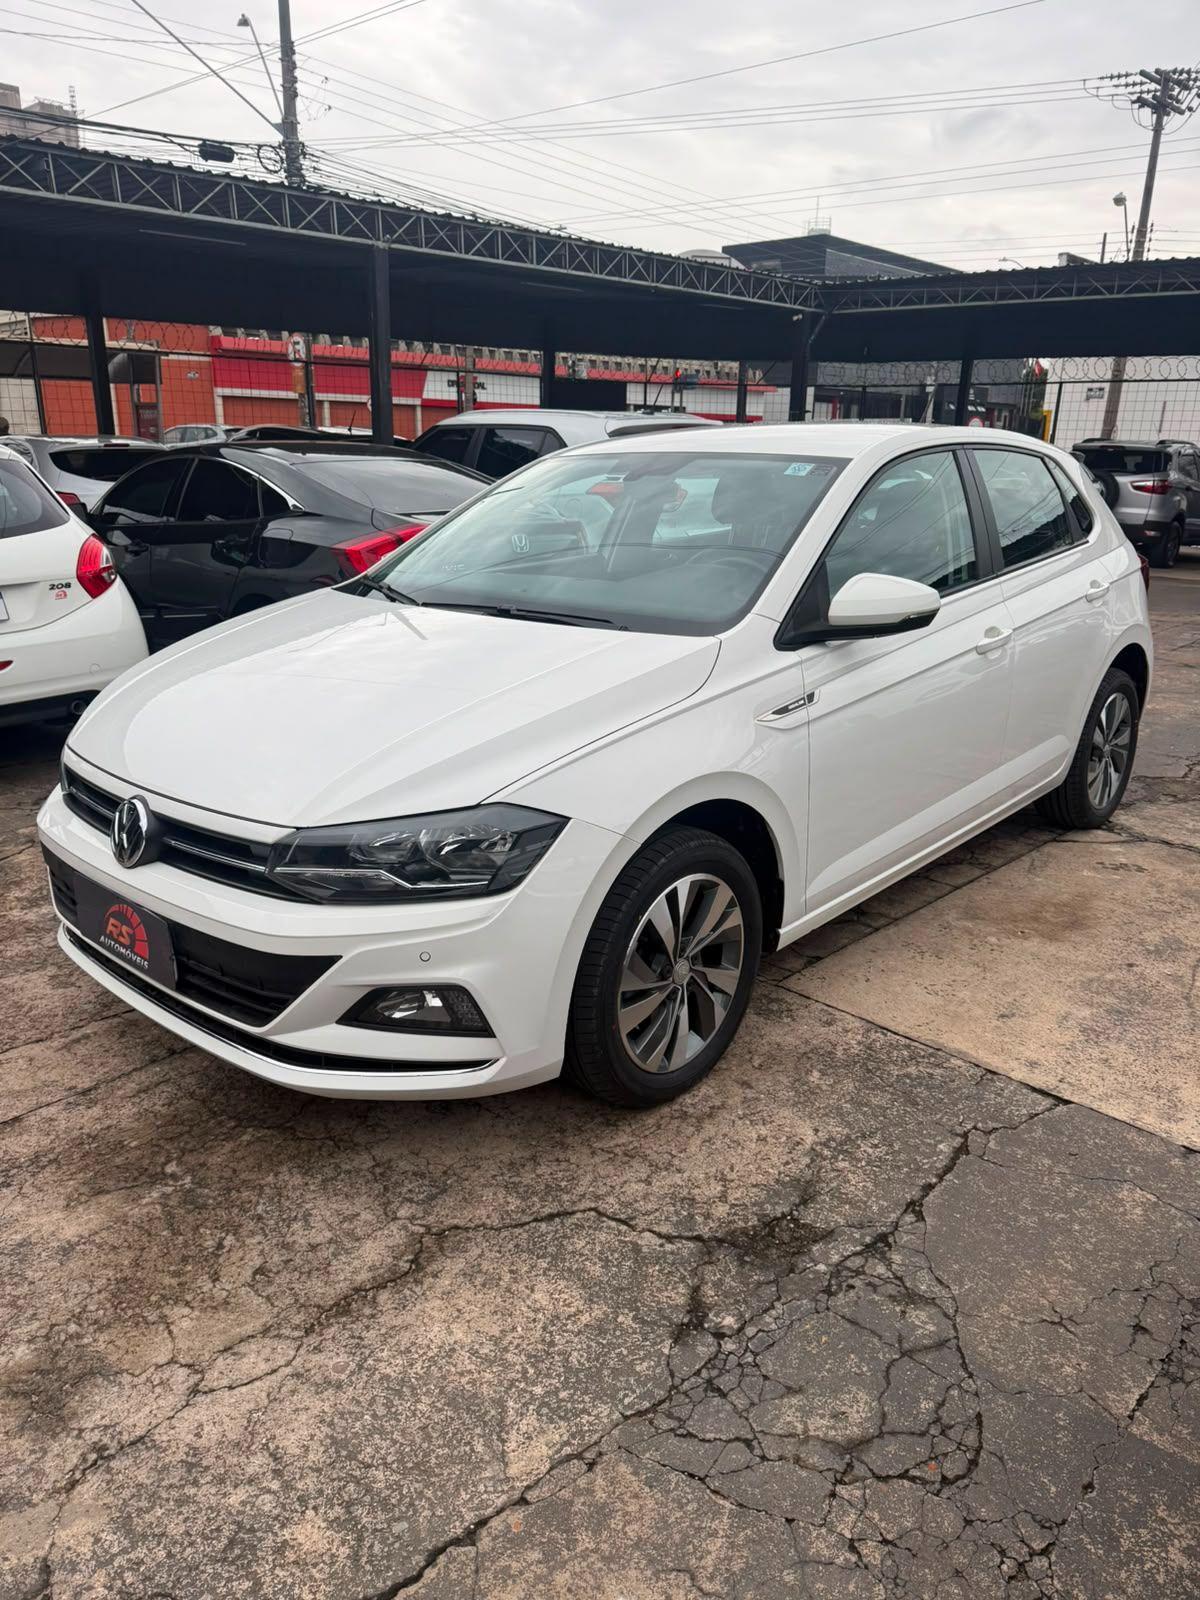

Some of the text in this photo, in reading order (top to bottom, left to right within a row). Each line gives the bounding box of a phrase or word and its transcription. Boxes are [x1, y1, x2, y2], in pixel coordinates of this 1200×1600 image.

[49, 582, 71, 590] 208
[106, 917, 134, 945] RS
[99, 935, 149, 969] AUTOMÓVEIS
